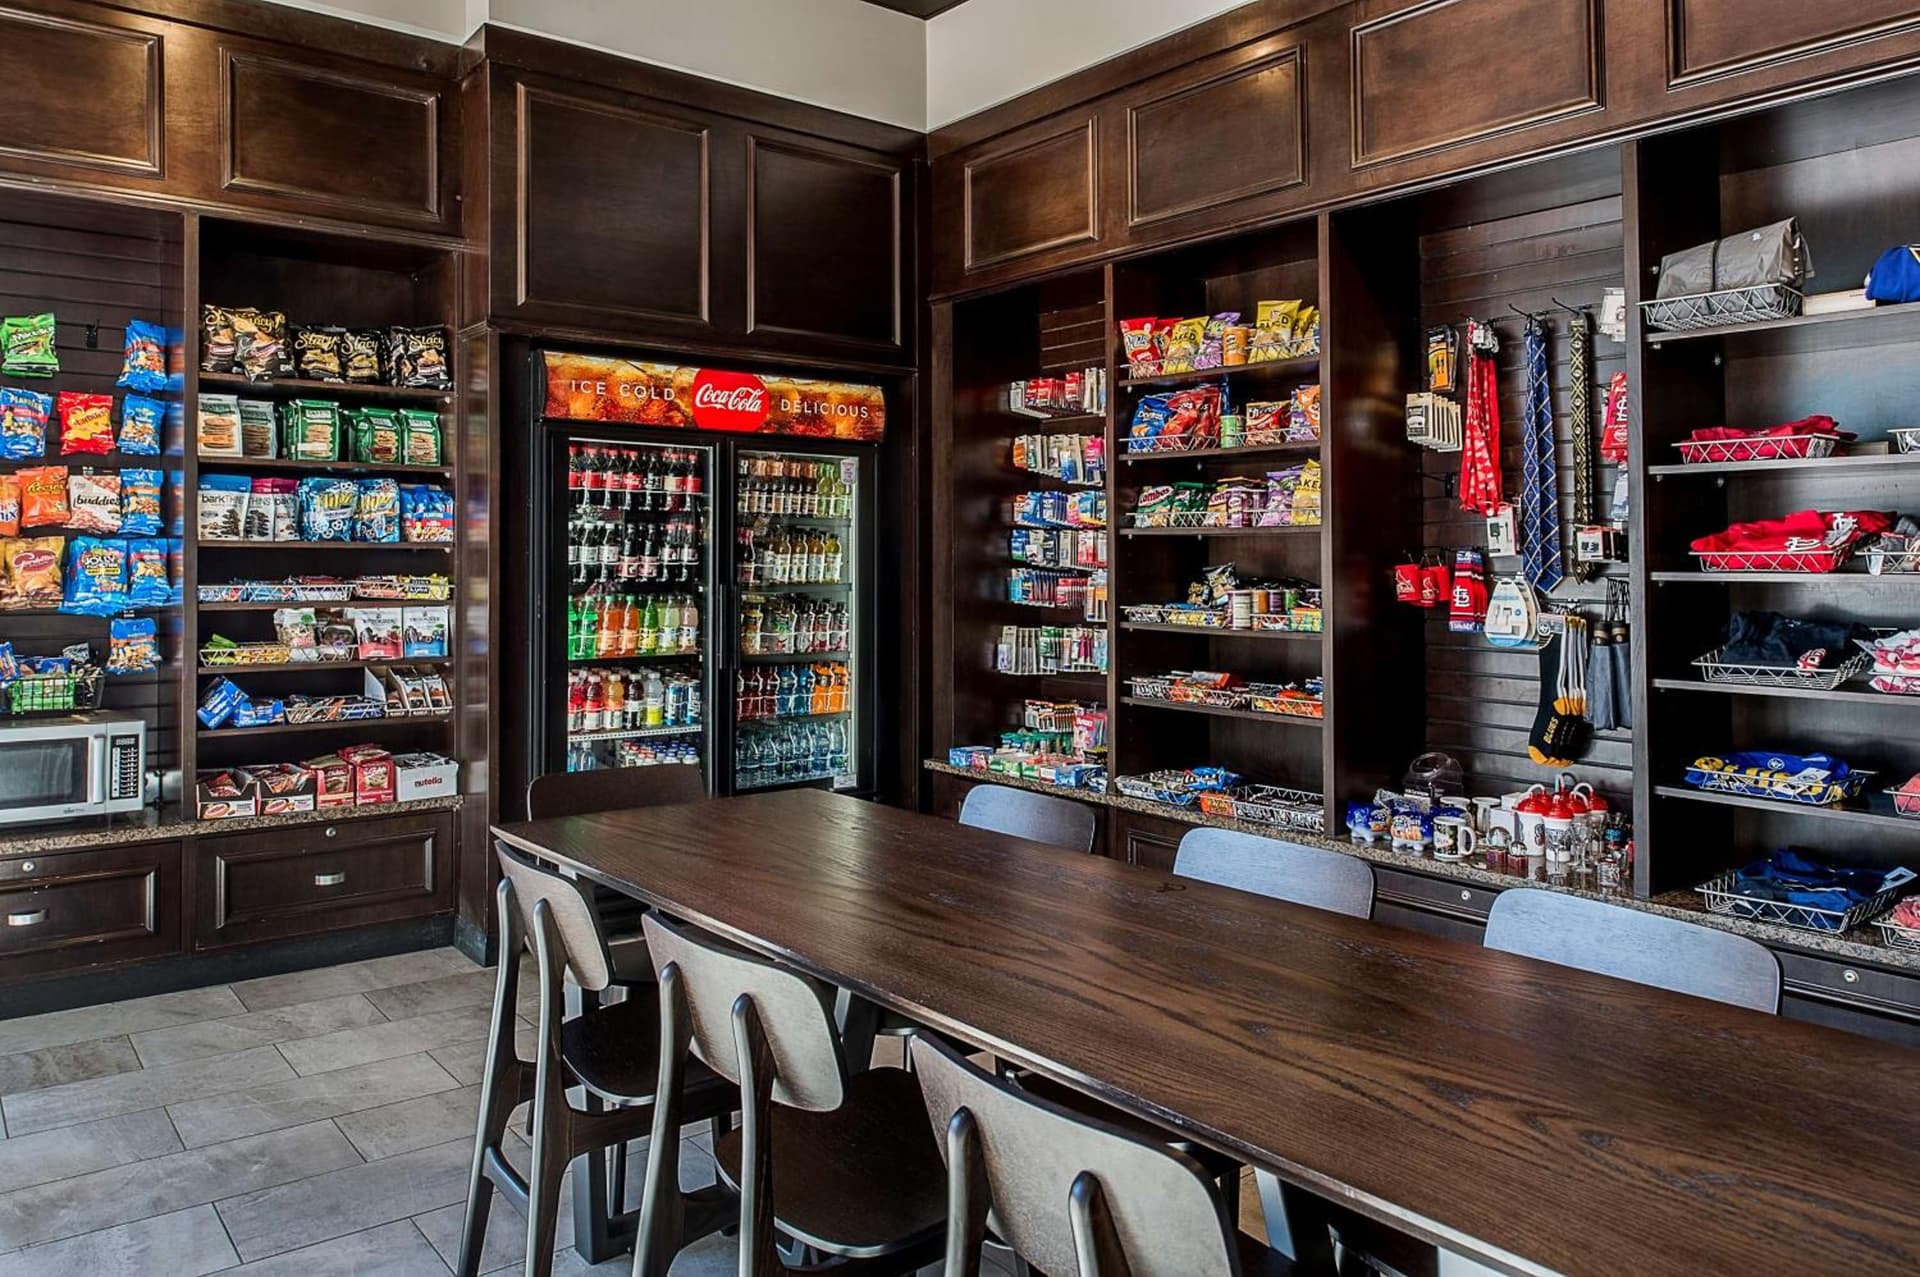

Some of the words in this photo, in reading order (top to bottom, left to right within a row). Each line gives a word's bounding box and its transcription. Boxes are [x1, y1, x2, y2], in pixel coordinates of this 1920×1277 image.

[571, 379, 606, 396] ICE
[619, 384, 675, 401] COLD
[695, 383, 763, 413] Coca-Cola
[779, 398, 869, 419] DELICIOUS
[414, 777, 444, 789] nutella
